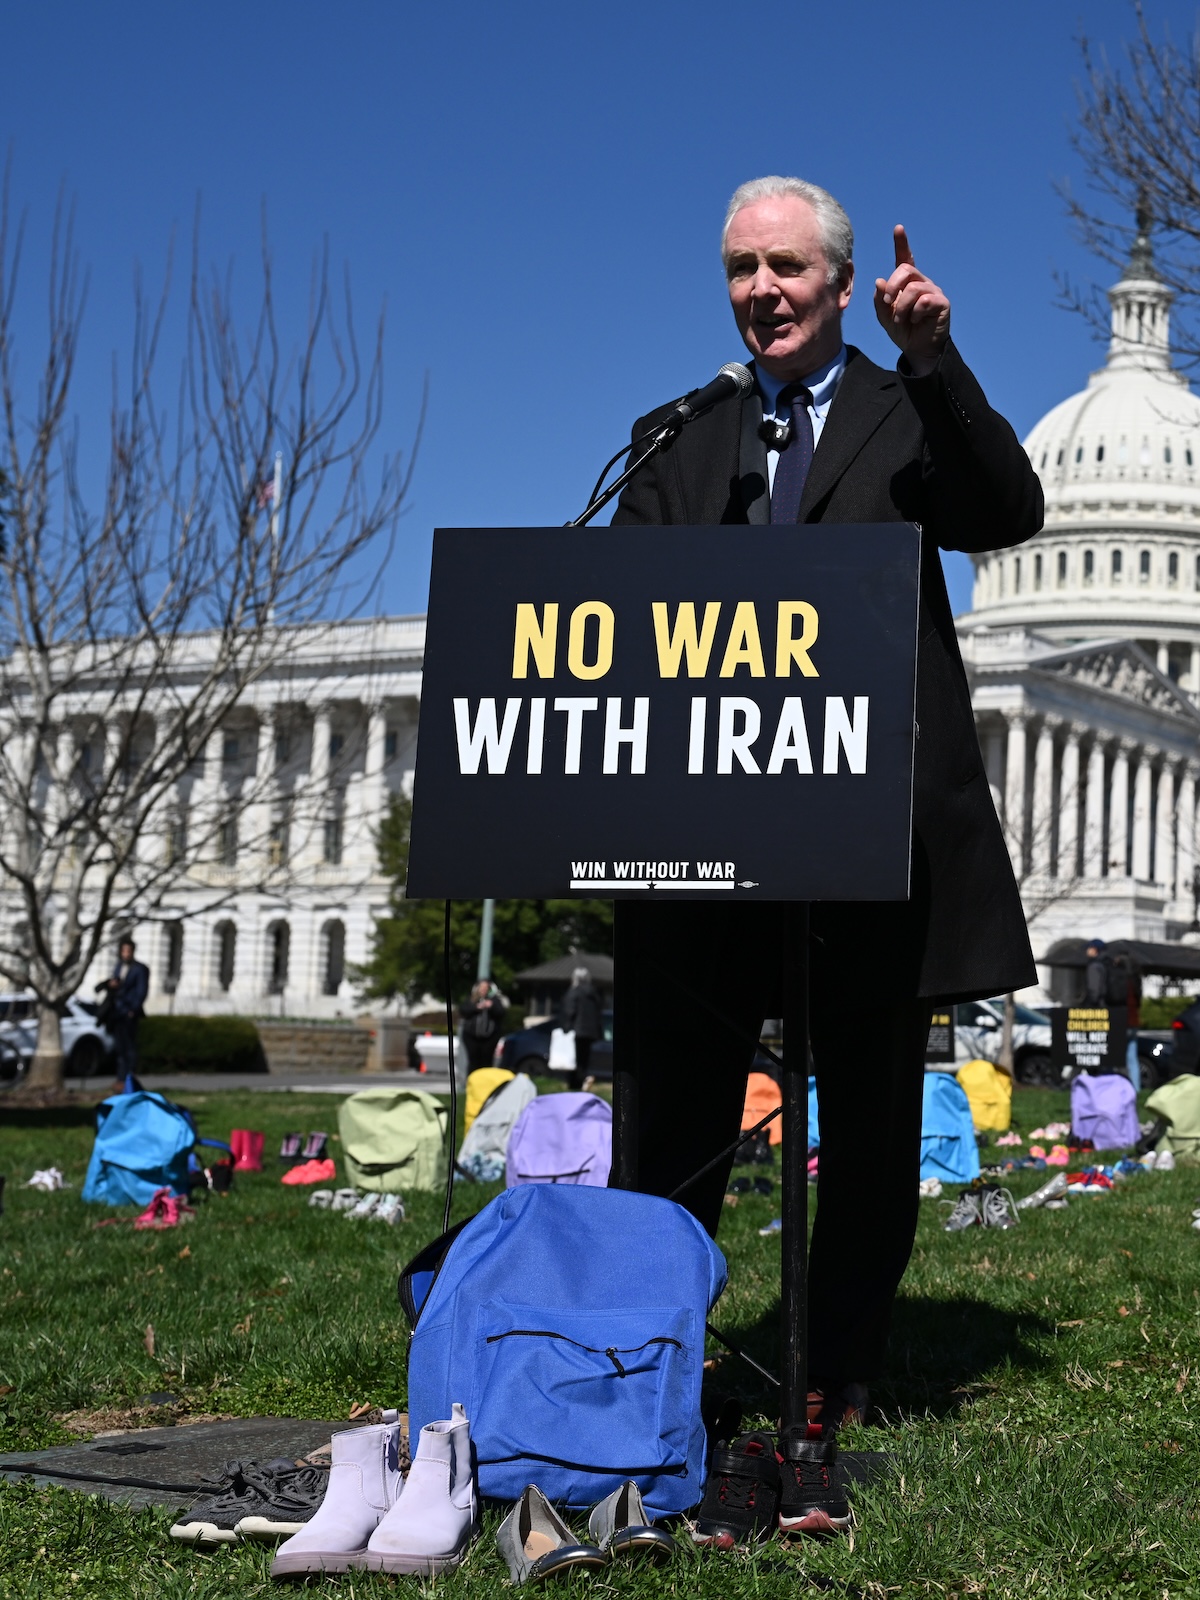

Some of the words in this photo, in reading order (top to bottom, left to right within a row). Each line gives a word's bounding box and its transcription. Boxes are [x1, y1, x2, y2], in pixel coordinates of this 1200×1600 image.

[512, 601, 616, 680] NO
[652, 601, 820, 679] WAR
[453, 697, 650, 775] WITH
[688, 696, 870, 775] IRAN
[571, 862, 606, 879] WIN
[613, 861, 689, 879] WITHOUT
[697, 861, 736, 879] WAR
[1068, 1008, 1109, 1019] BOMBING
[1067, 1020, 1110, 1031] CHILDREN
[1066, 1031, 1087, 1043] WILL
[1089, 1031, 1107, 1042] NOT
[1068, 1043, 1108, 1054] LIBERATE
[1076, 1054, 1100, 1066] THEM
